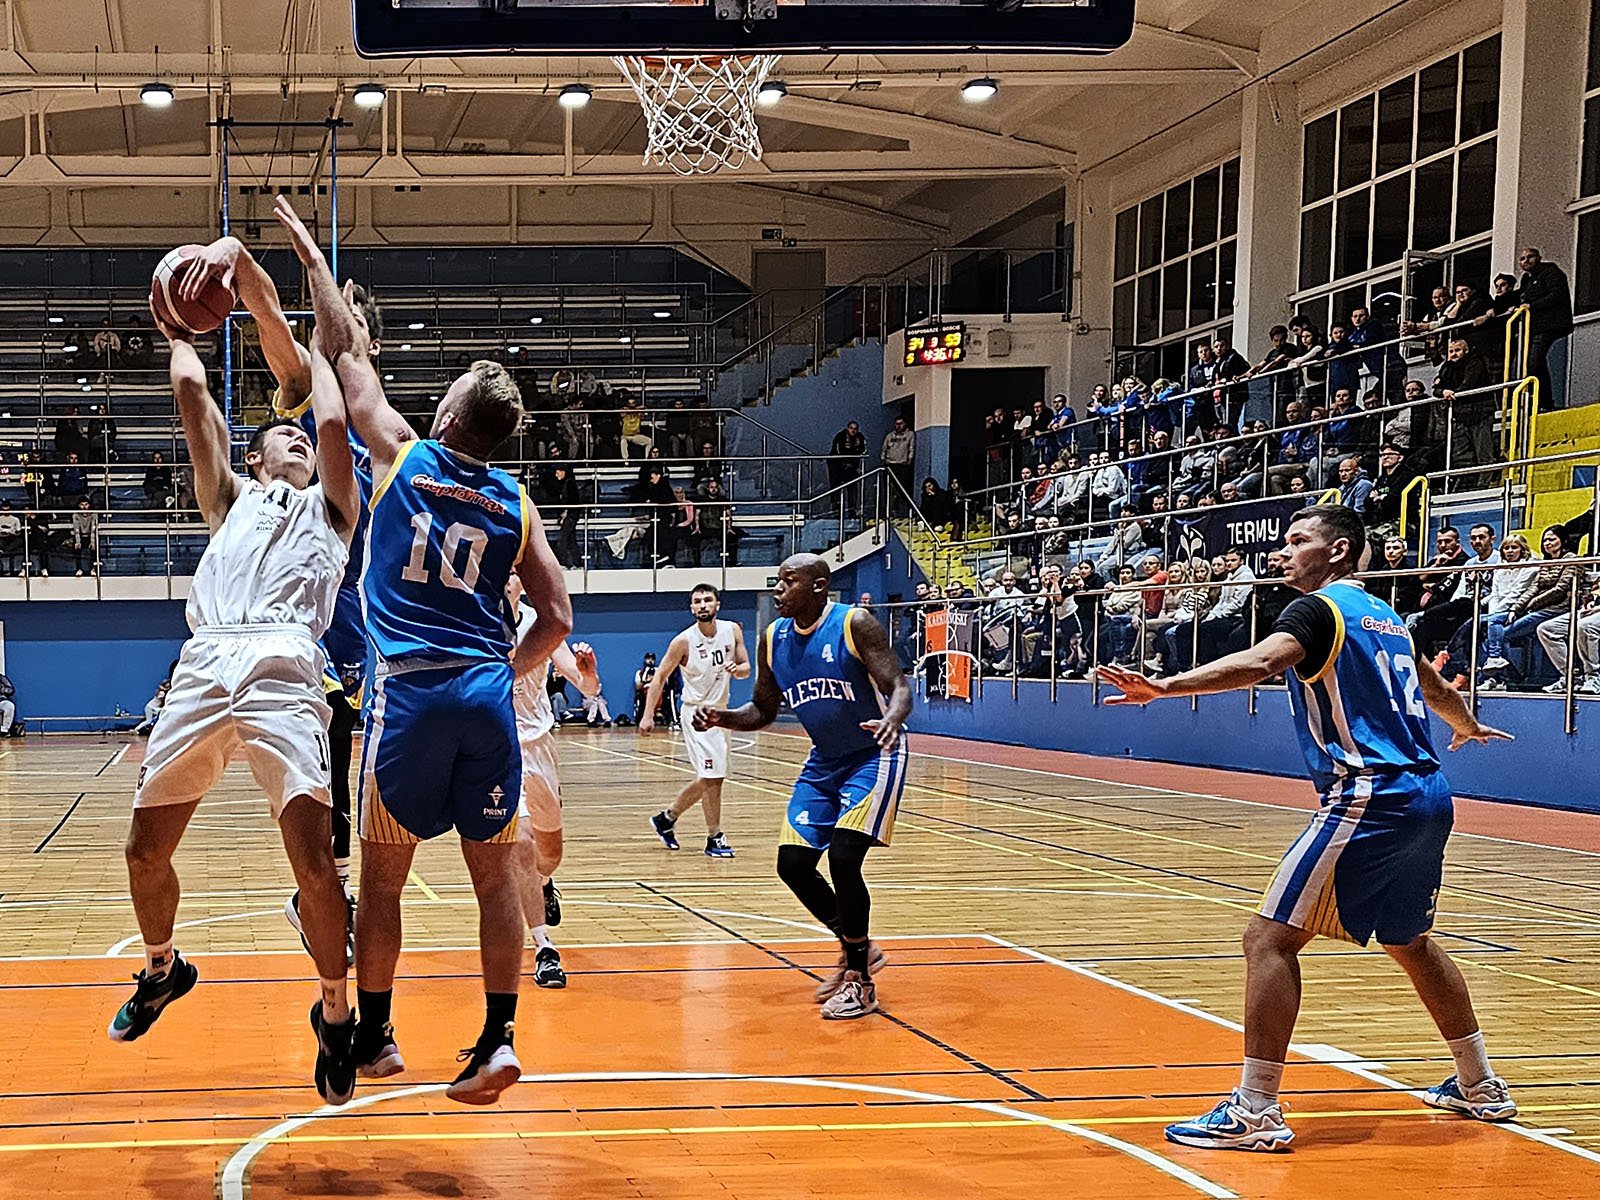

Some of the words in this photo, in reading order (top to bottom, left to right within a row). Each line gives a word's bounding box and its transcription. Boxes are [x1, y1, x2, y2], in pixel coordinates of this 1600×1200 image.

[908, 337, 924, 351] 34
[1226, 517, 1281, 546] TERMY
[401, 511, 489, 595] 10
[711, 649, 725, 667] 10
[821, 643, 835, 663] 4
[781, 677, 856, 709] LESZEW
[1375, 649, 1426, 719] 12
[483, 807, 508, 816] PRINT
[795, 810, 809, 825] 4
